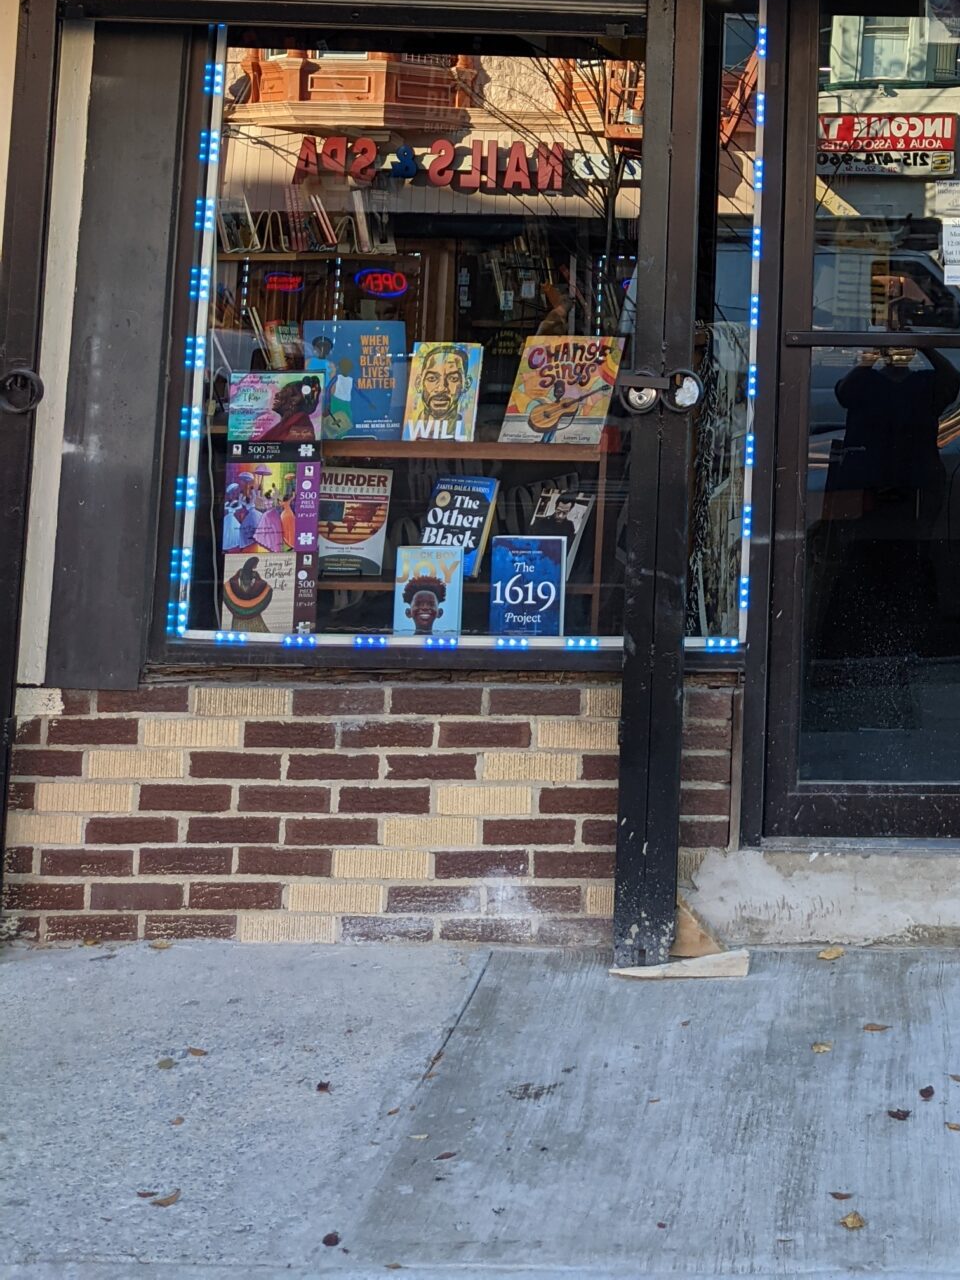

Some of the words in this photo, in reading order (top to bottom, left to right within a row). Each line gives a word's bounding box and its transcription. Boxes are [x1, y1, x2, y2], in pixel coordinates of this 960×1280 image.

[360, 335, 389, 346] WHEN
[360, 355, 392, 366] BLACK
[362, 367, 390, 377] LIVES
[357, 378, 396, 389] MATTER
[406, 419, 468, 441] WILL
[248, 445, 265, 454] 500
[320, 472, 389, 488] MURDER
[300, 491, 317, 500] 500
[322, 486, 388, 494] NCORPORATED
[453, 494, 480, 509] The
[427, 507, 484, 528] Other
[421, 526, 477, 548] Black
[395, 561, 460, 583] JOY
[513, 562, 535, 573] The
[298, 580, 315, 589] 500
[492, 573, 556, 612] 1619
[504, 612, 542, 625] Project
